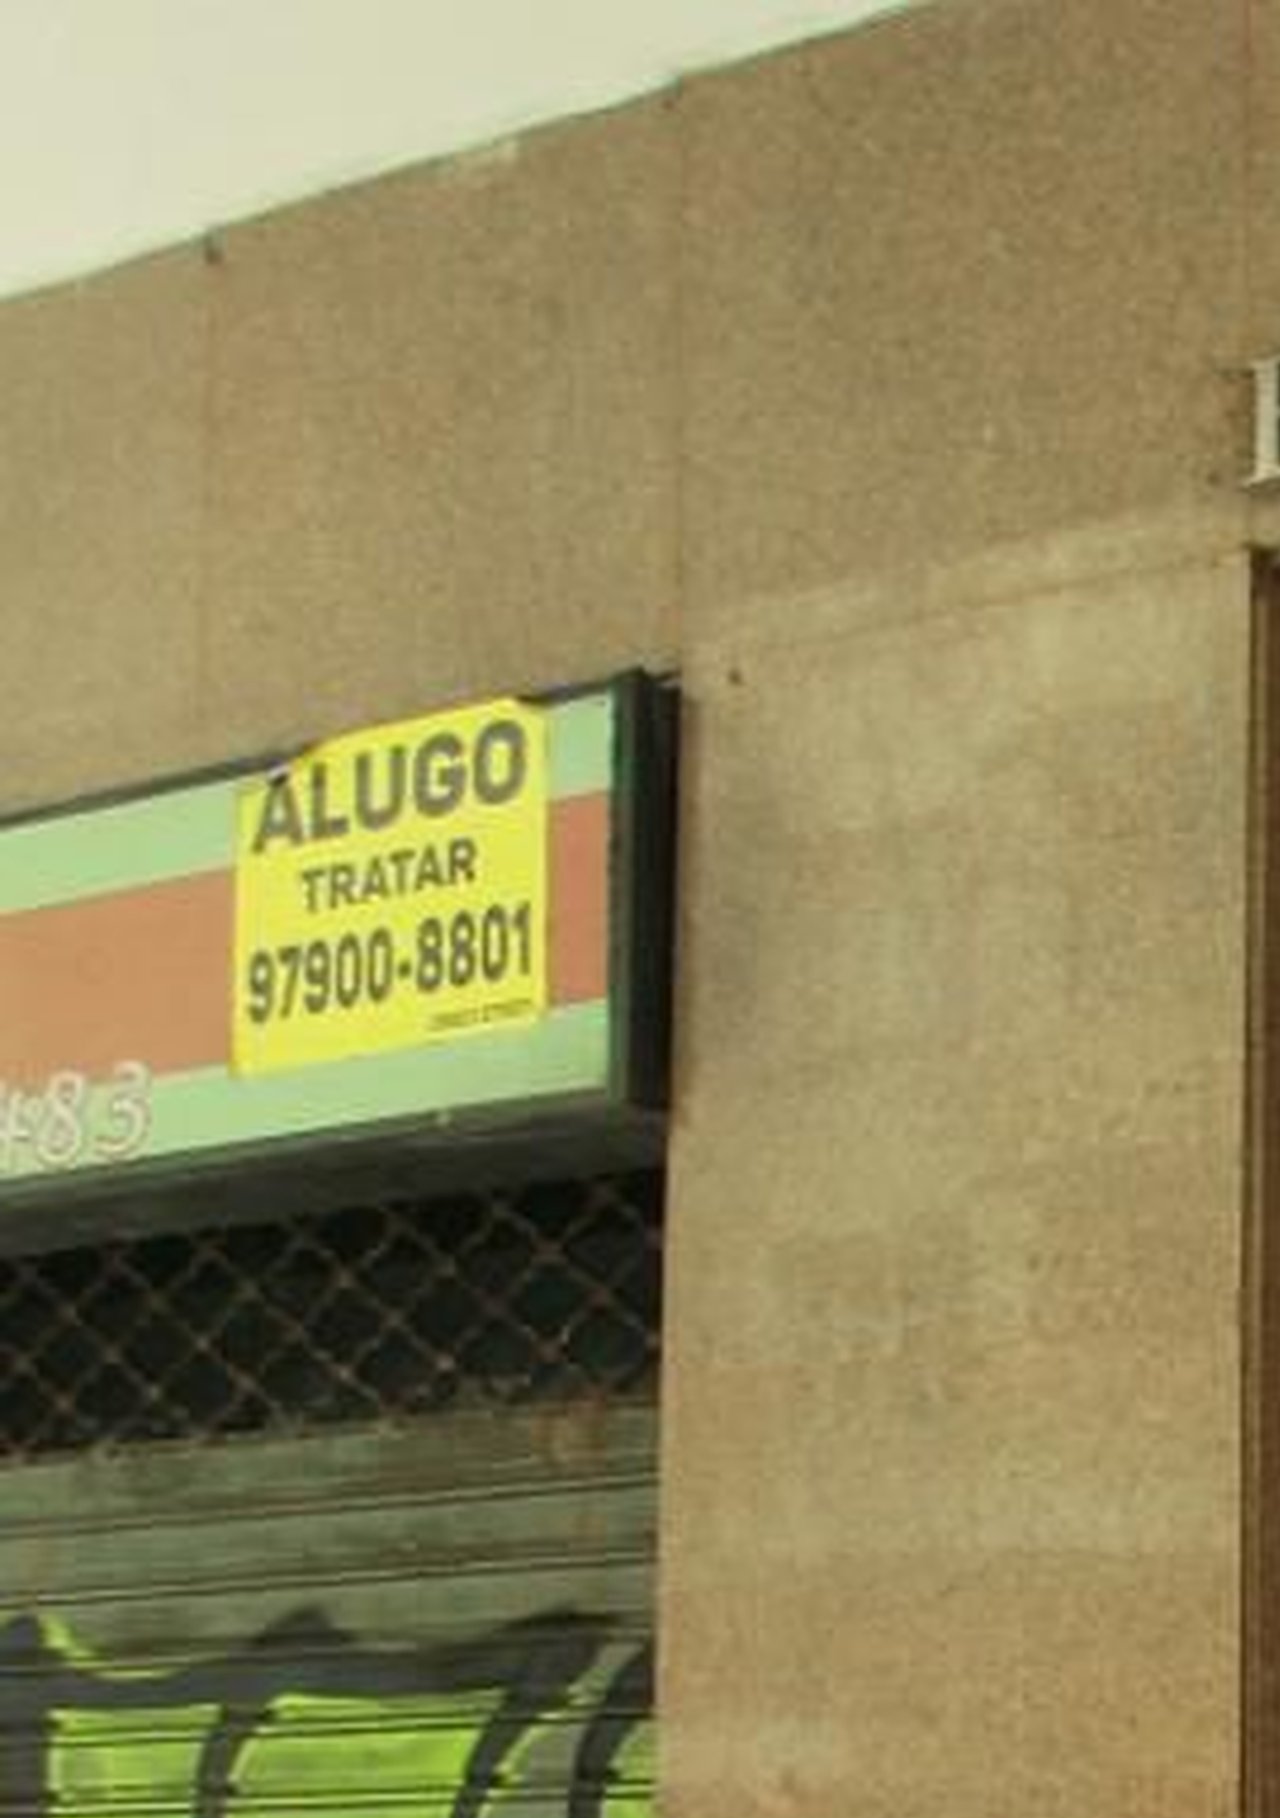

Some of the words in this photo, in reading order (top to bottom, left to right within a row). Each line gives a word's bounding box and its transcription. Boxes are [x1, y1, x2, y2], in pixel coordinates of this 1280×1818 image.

[251, 719, 527, 855] ALUGO
[302, 837, 478, 913] TRATAR
[247, 901, 531, 1025] 97900-8801
